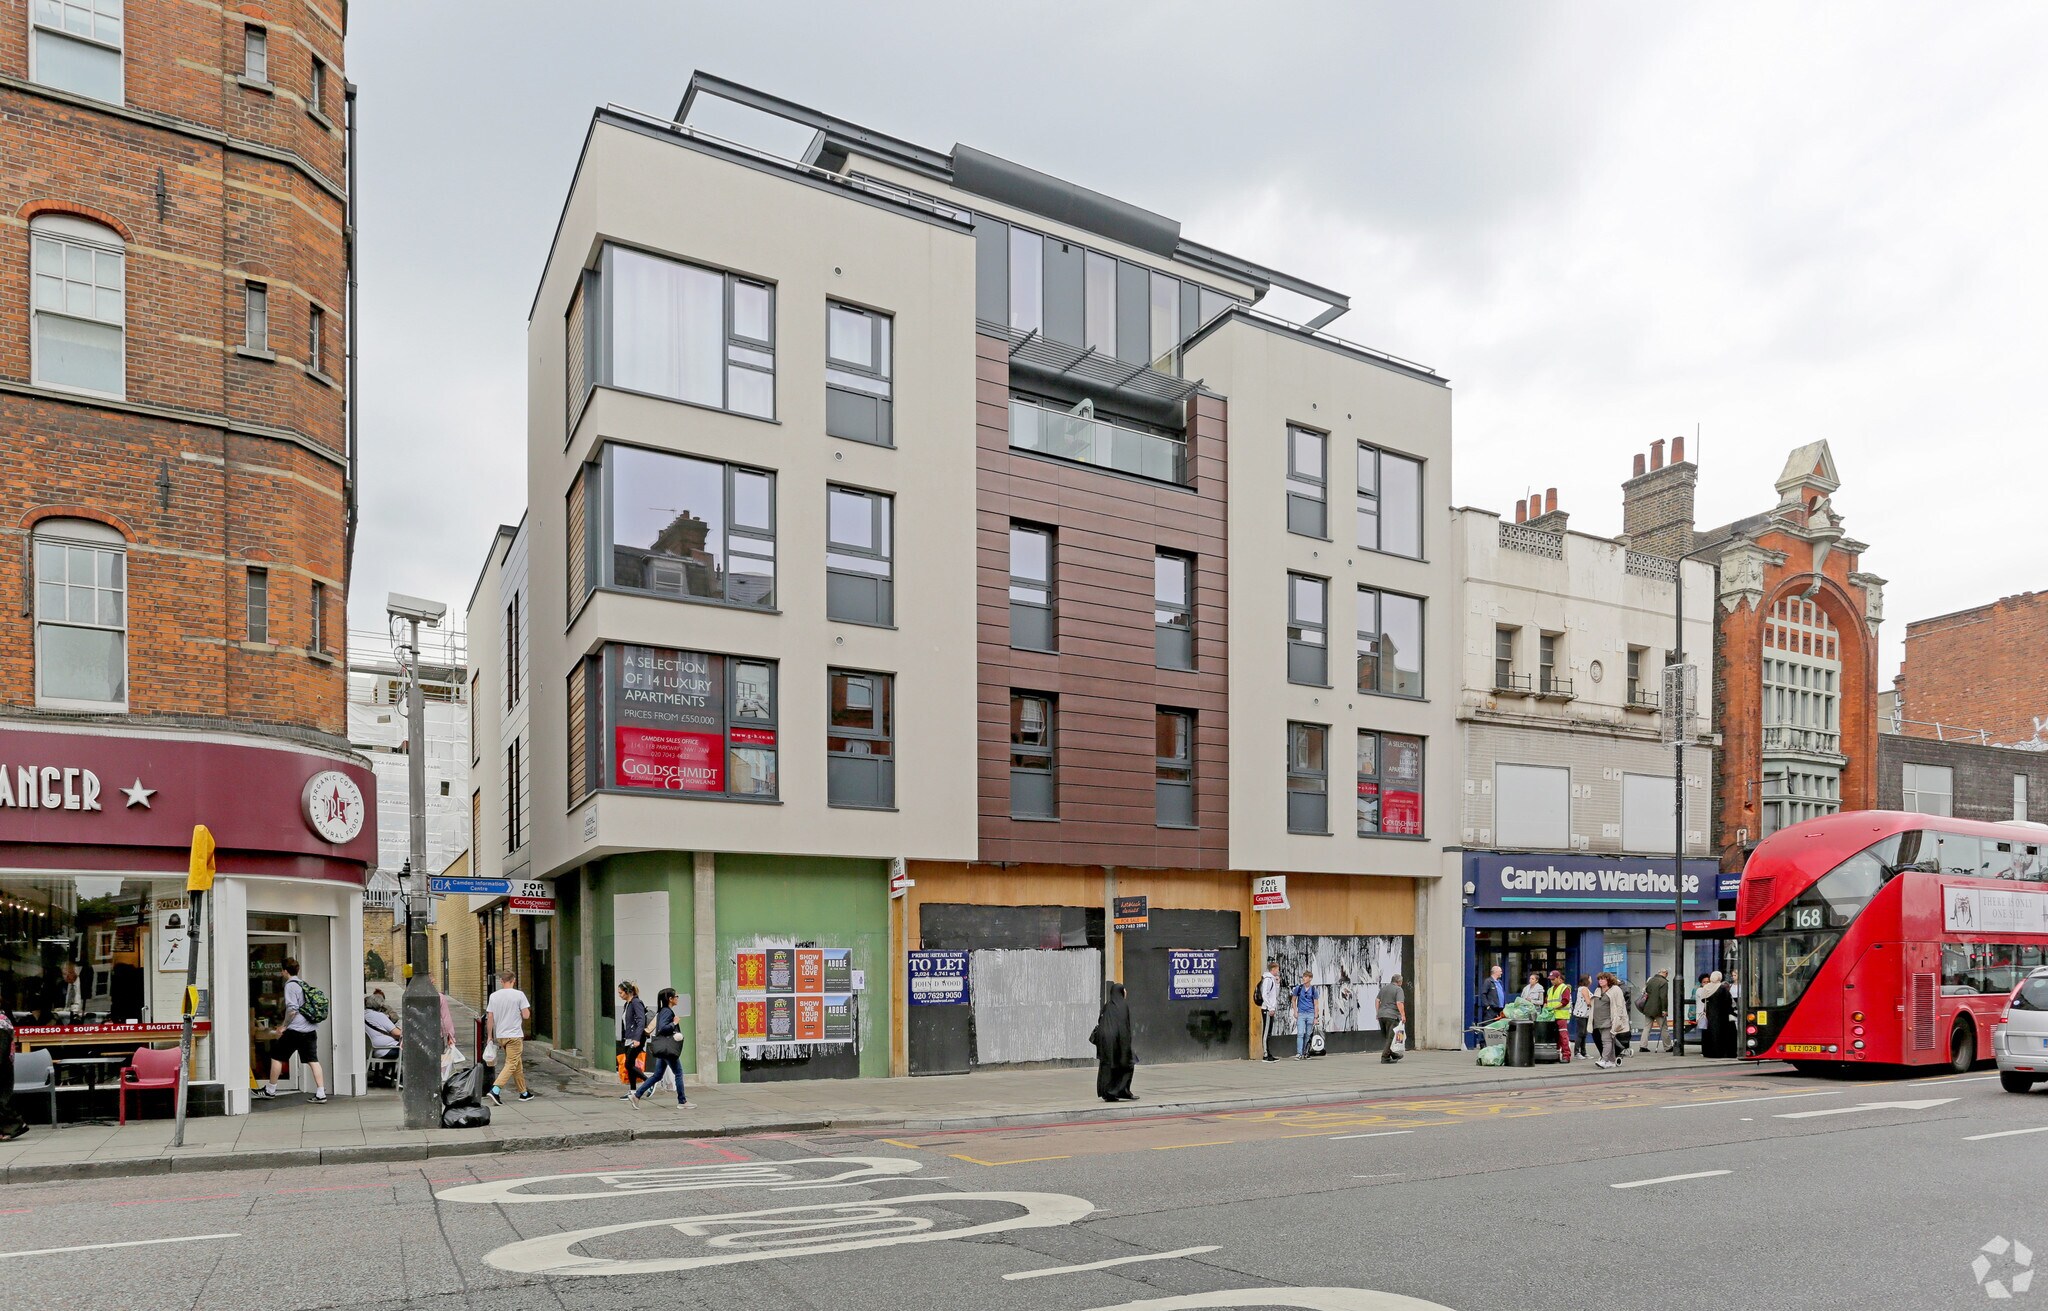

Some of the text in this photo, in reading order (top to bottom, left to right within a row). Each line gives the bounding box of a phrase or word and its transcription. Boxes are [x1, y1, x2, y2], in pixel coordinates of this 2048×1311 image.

[624, 656, 705, 674] A SELECTION
[625, 672, 712, 692] OF 14 LUXURY
[624, 690, 705, 708] APARTMENTS
[624, 709, 715, 725] PRICES FROM £550,000
[622, 758, 718, 779] GOLDSCHMIDT
[0, 764, 102, 811] ANGER
[312, 775, 360, 806] ORGANIC COFFEE
[1500, 866, 1700, 894] Carphone Warehouse
[1983, 897, 2006, 906] THERE
[2015, 898, 2032, 908] ONLY
[1796, 909, 1820, 927] 168
[1992, 909, 2007, 918] ONE
[908, 958, 966, 971] TO LET
[1172, 958, 1216, 969] TO LET
